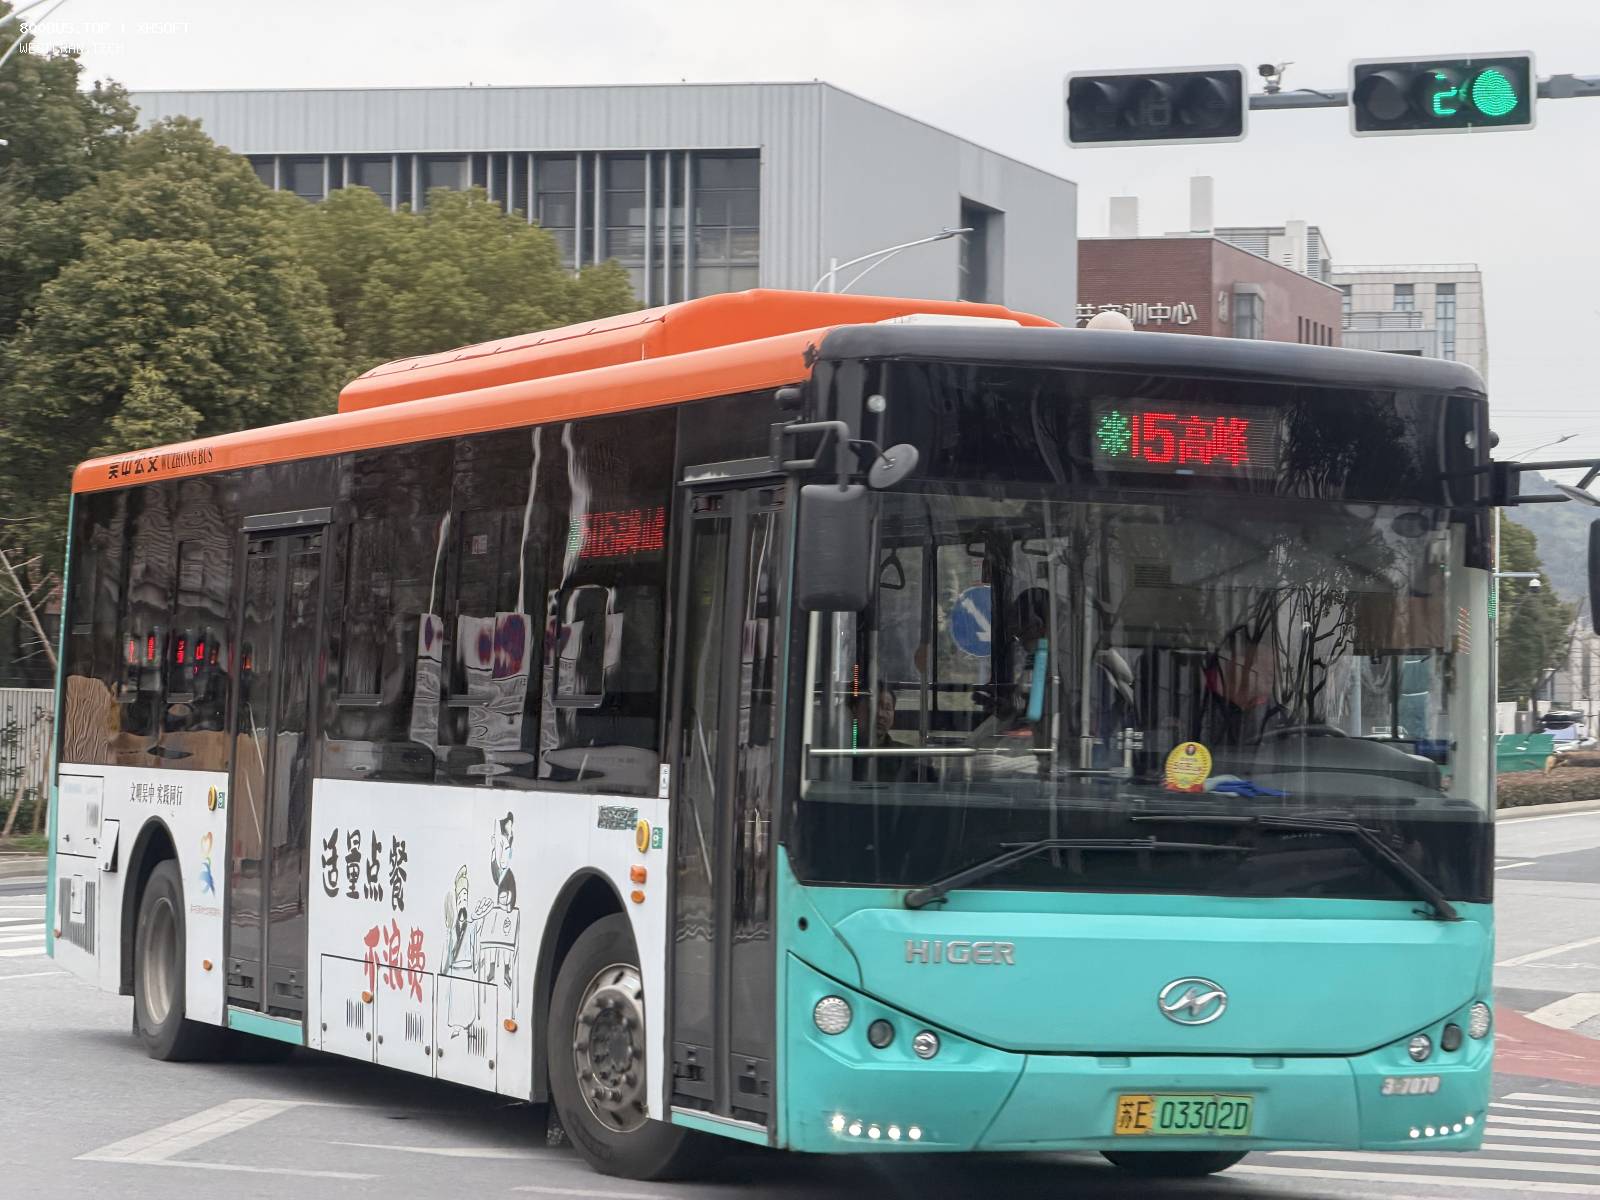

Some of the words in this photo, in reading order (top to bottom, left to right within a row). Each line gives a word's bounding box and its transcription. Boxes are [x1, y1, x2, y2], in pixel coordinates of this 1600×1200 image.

[321, 827, 408, 912] 适量点餐
[363, 917, 426, 1003] 不浪费
[904, 939, 1015, 965] HIGER
